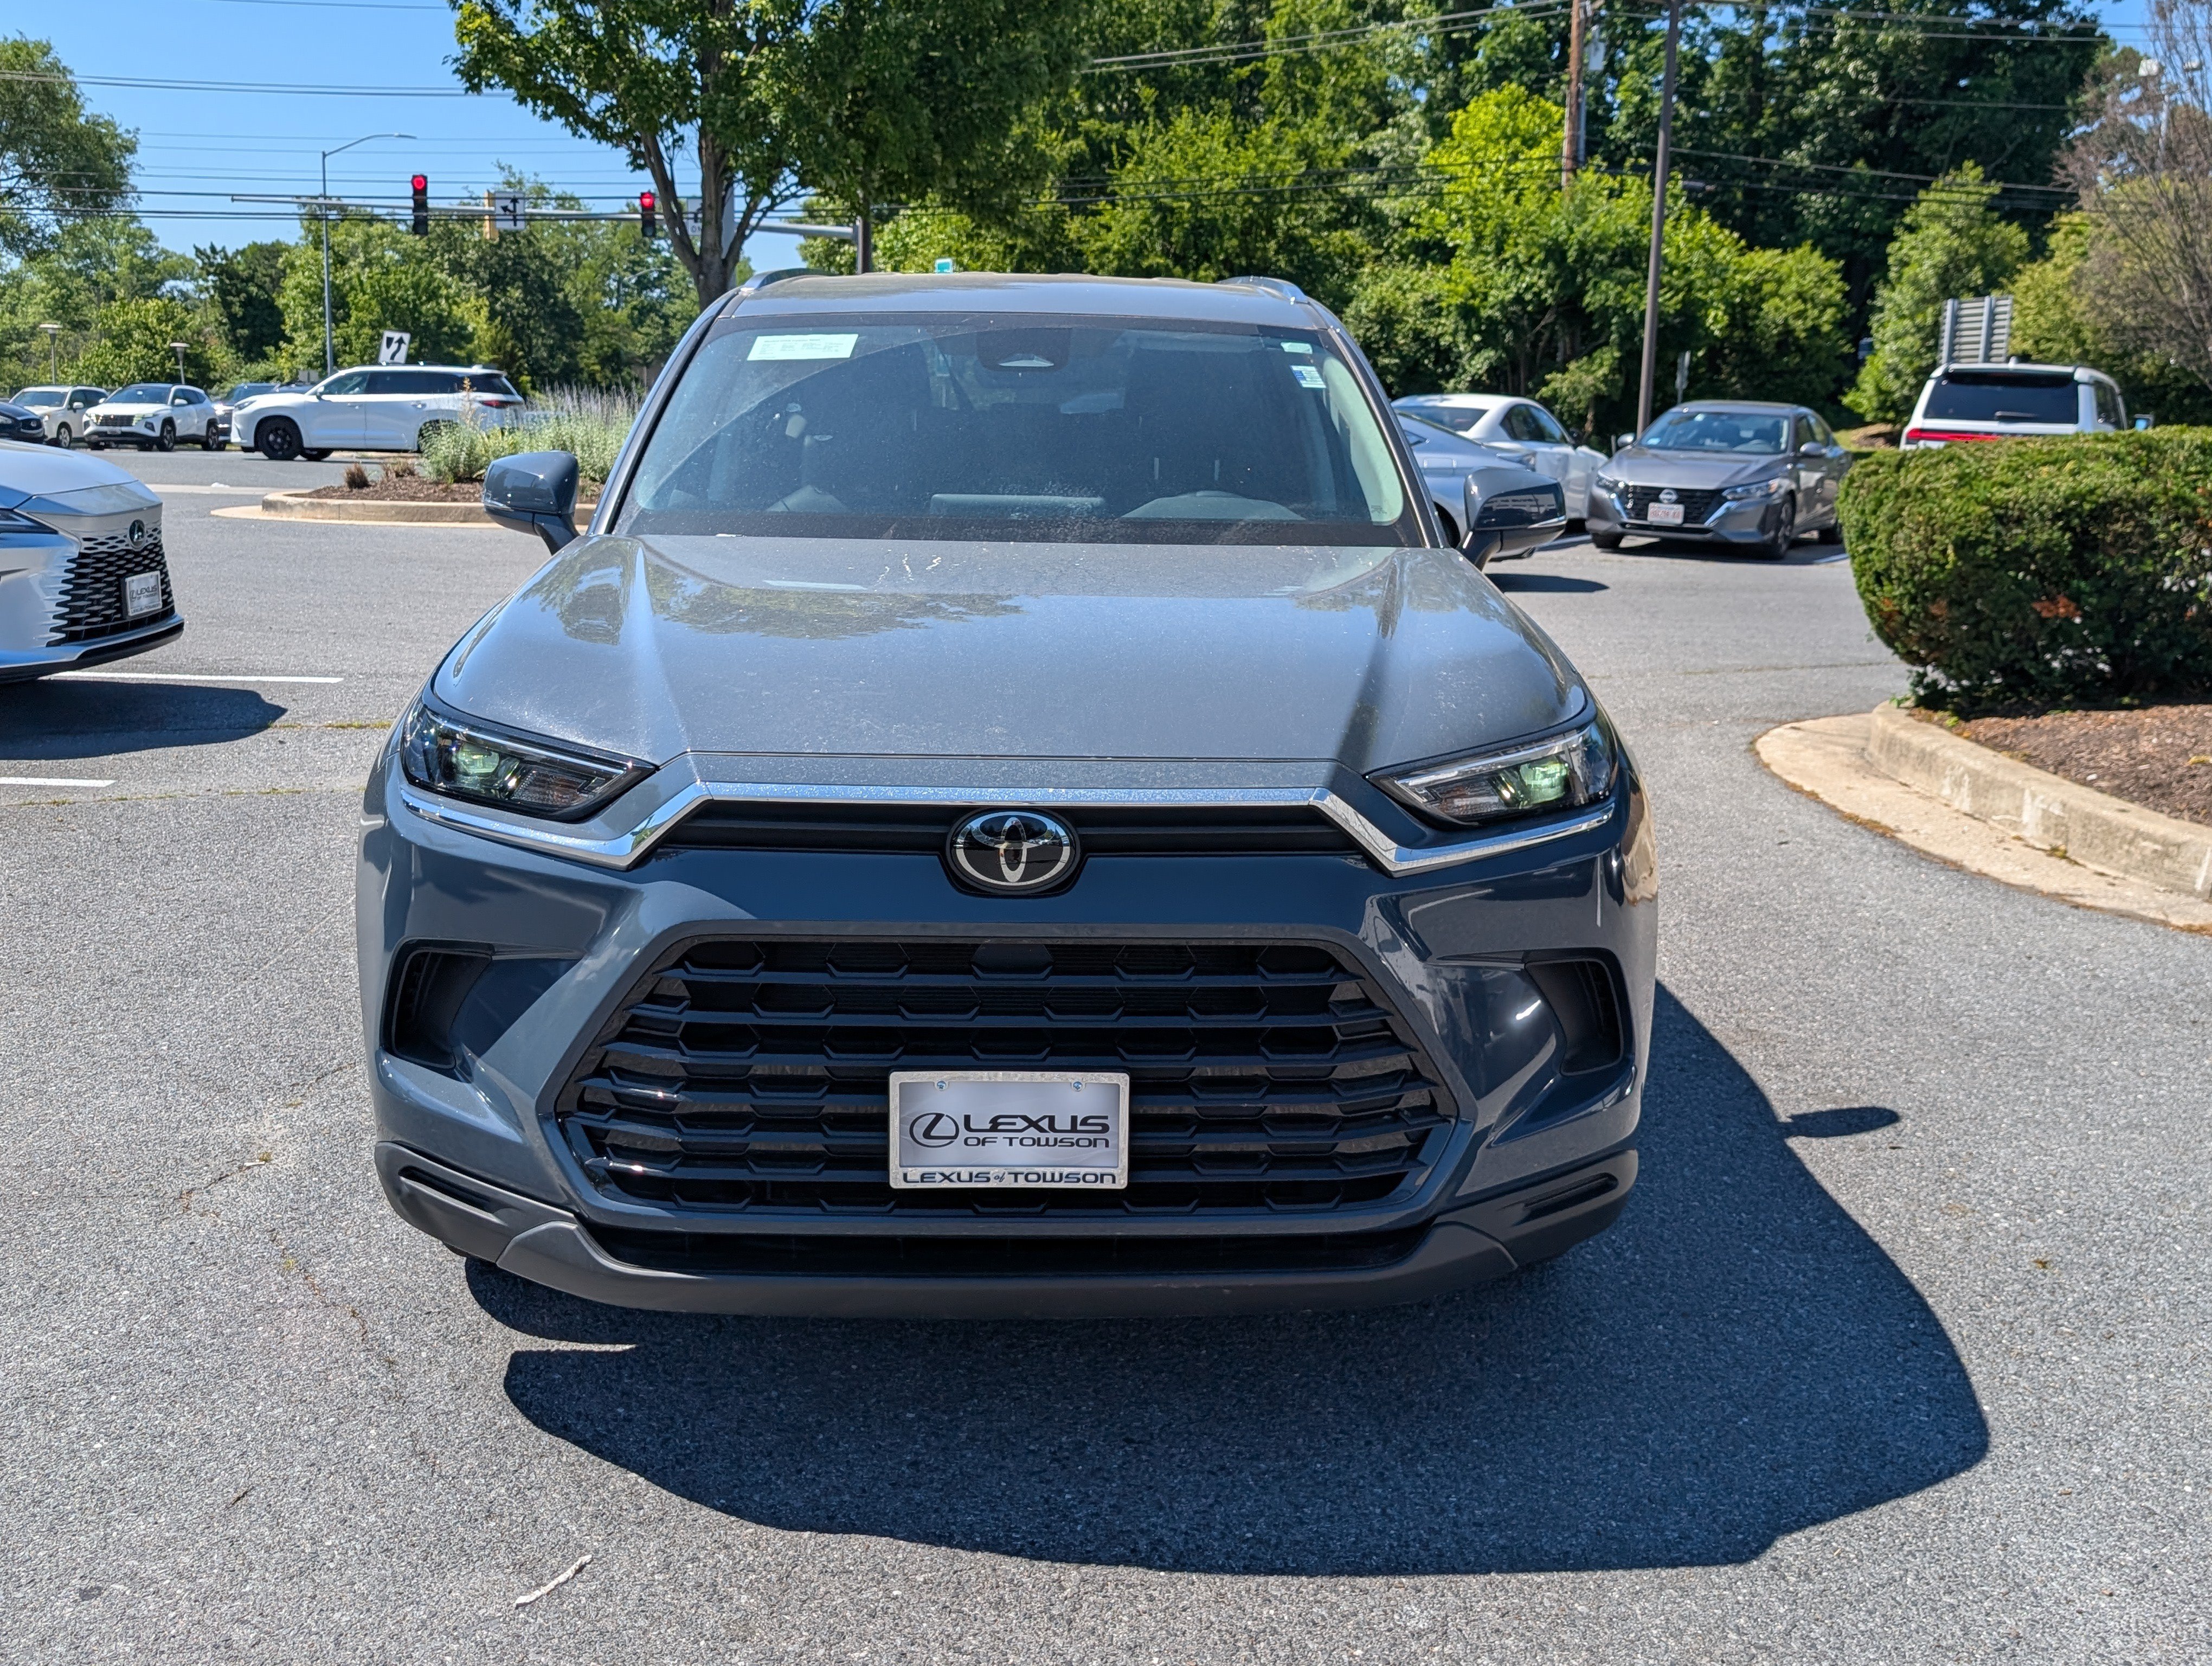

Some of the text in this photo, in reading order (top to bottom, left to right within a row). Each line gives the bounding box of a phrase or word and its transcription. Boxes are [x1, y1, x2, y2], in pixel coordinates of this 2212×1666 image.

[136, 586, 157, 595] LEXUS
[963, 1114, 1110, 1133] LEXUS
[963, 1137, 1109, 1148] OF TOWSON
[903, 1171, 1116, 1184] LEXUS of TOWSON
